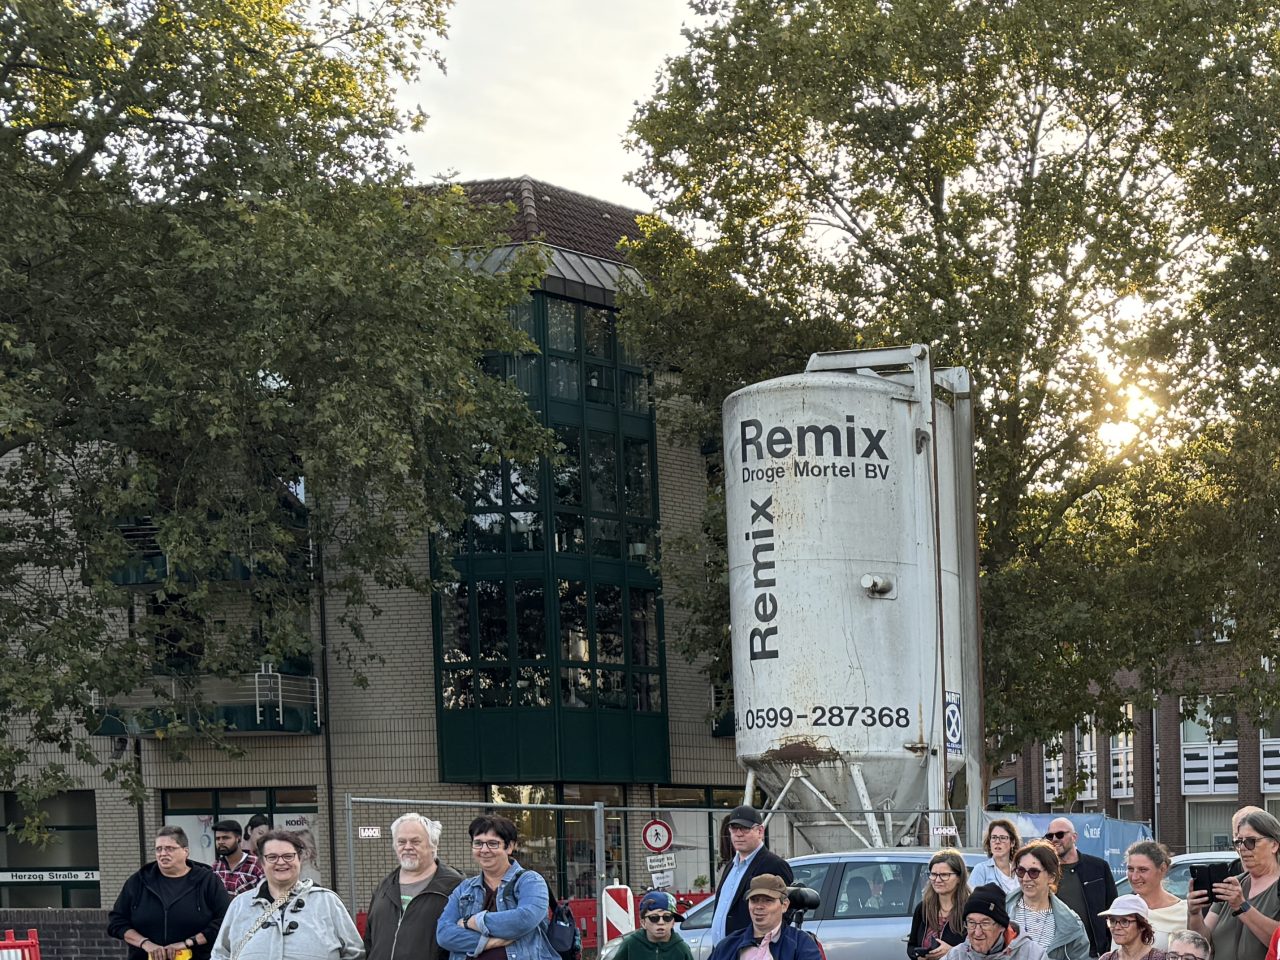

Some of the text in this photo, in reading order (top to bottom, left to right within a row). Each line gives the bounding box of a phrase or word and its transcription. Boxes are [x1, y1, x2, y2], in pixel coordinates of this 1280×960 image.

[741, 415, 889, 463] Remix
[742, 460, 890, 484] Droge Mortel BV
[745, 495, 779, 661] Remix
[745, 705, 911, 730] 0599-287368
[11, 872, 44, 881] Herzog
[48, 872, 79, 880] Straße
